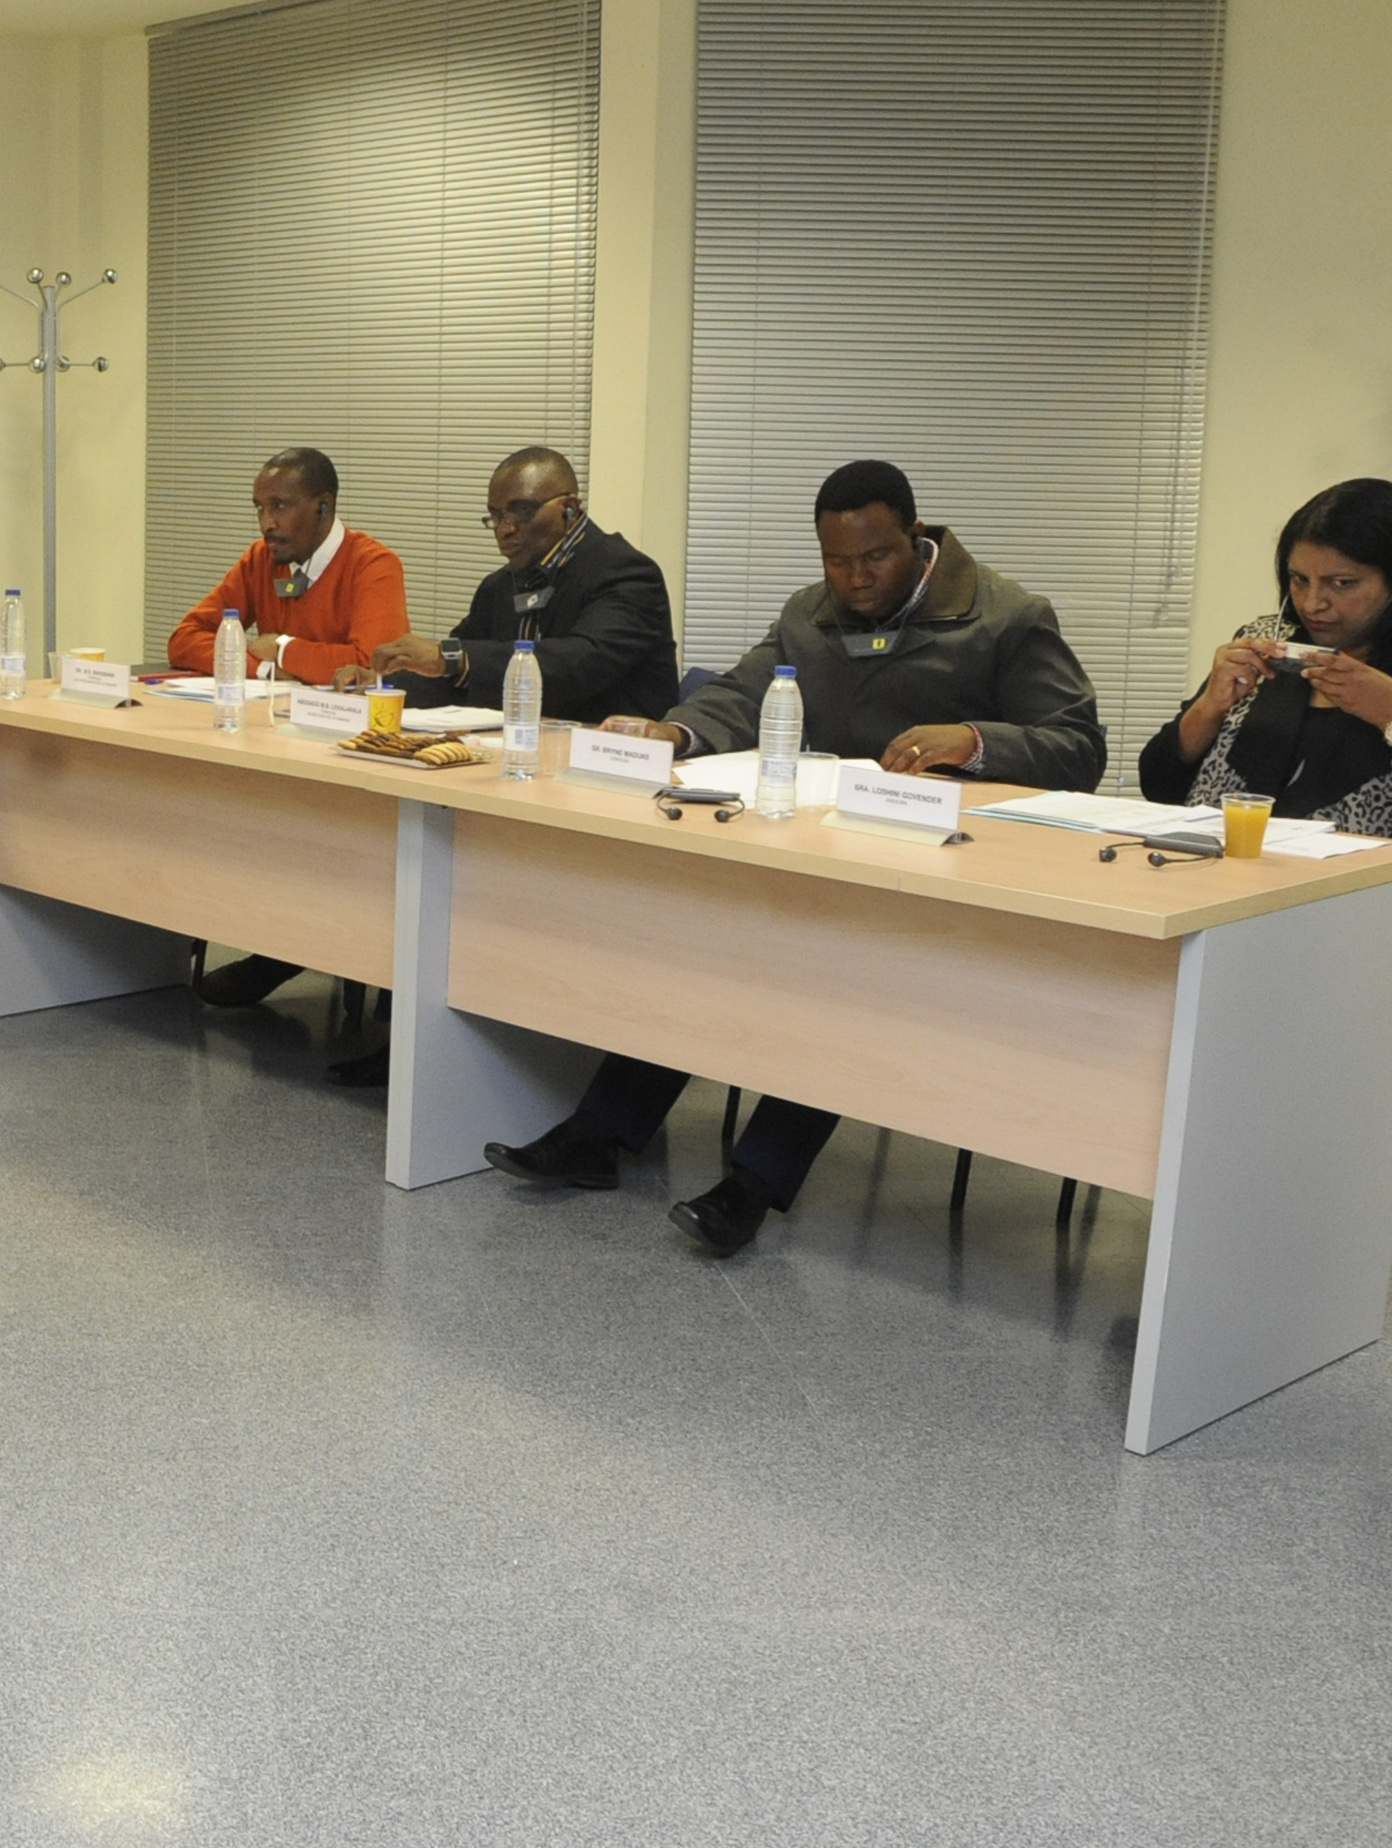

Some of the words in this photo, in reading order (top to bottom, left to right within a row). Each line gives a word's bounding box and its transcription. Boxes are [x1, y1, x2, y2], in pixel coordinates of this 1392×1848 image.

[854, 783, 871, 794] SRA.
[872, 786, 901, 799] LOSHINI
[902, 791, 943, 805] GOVENDER
